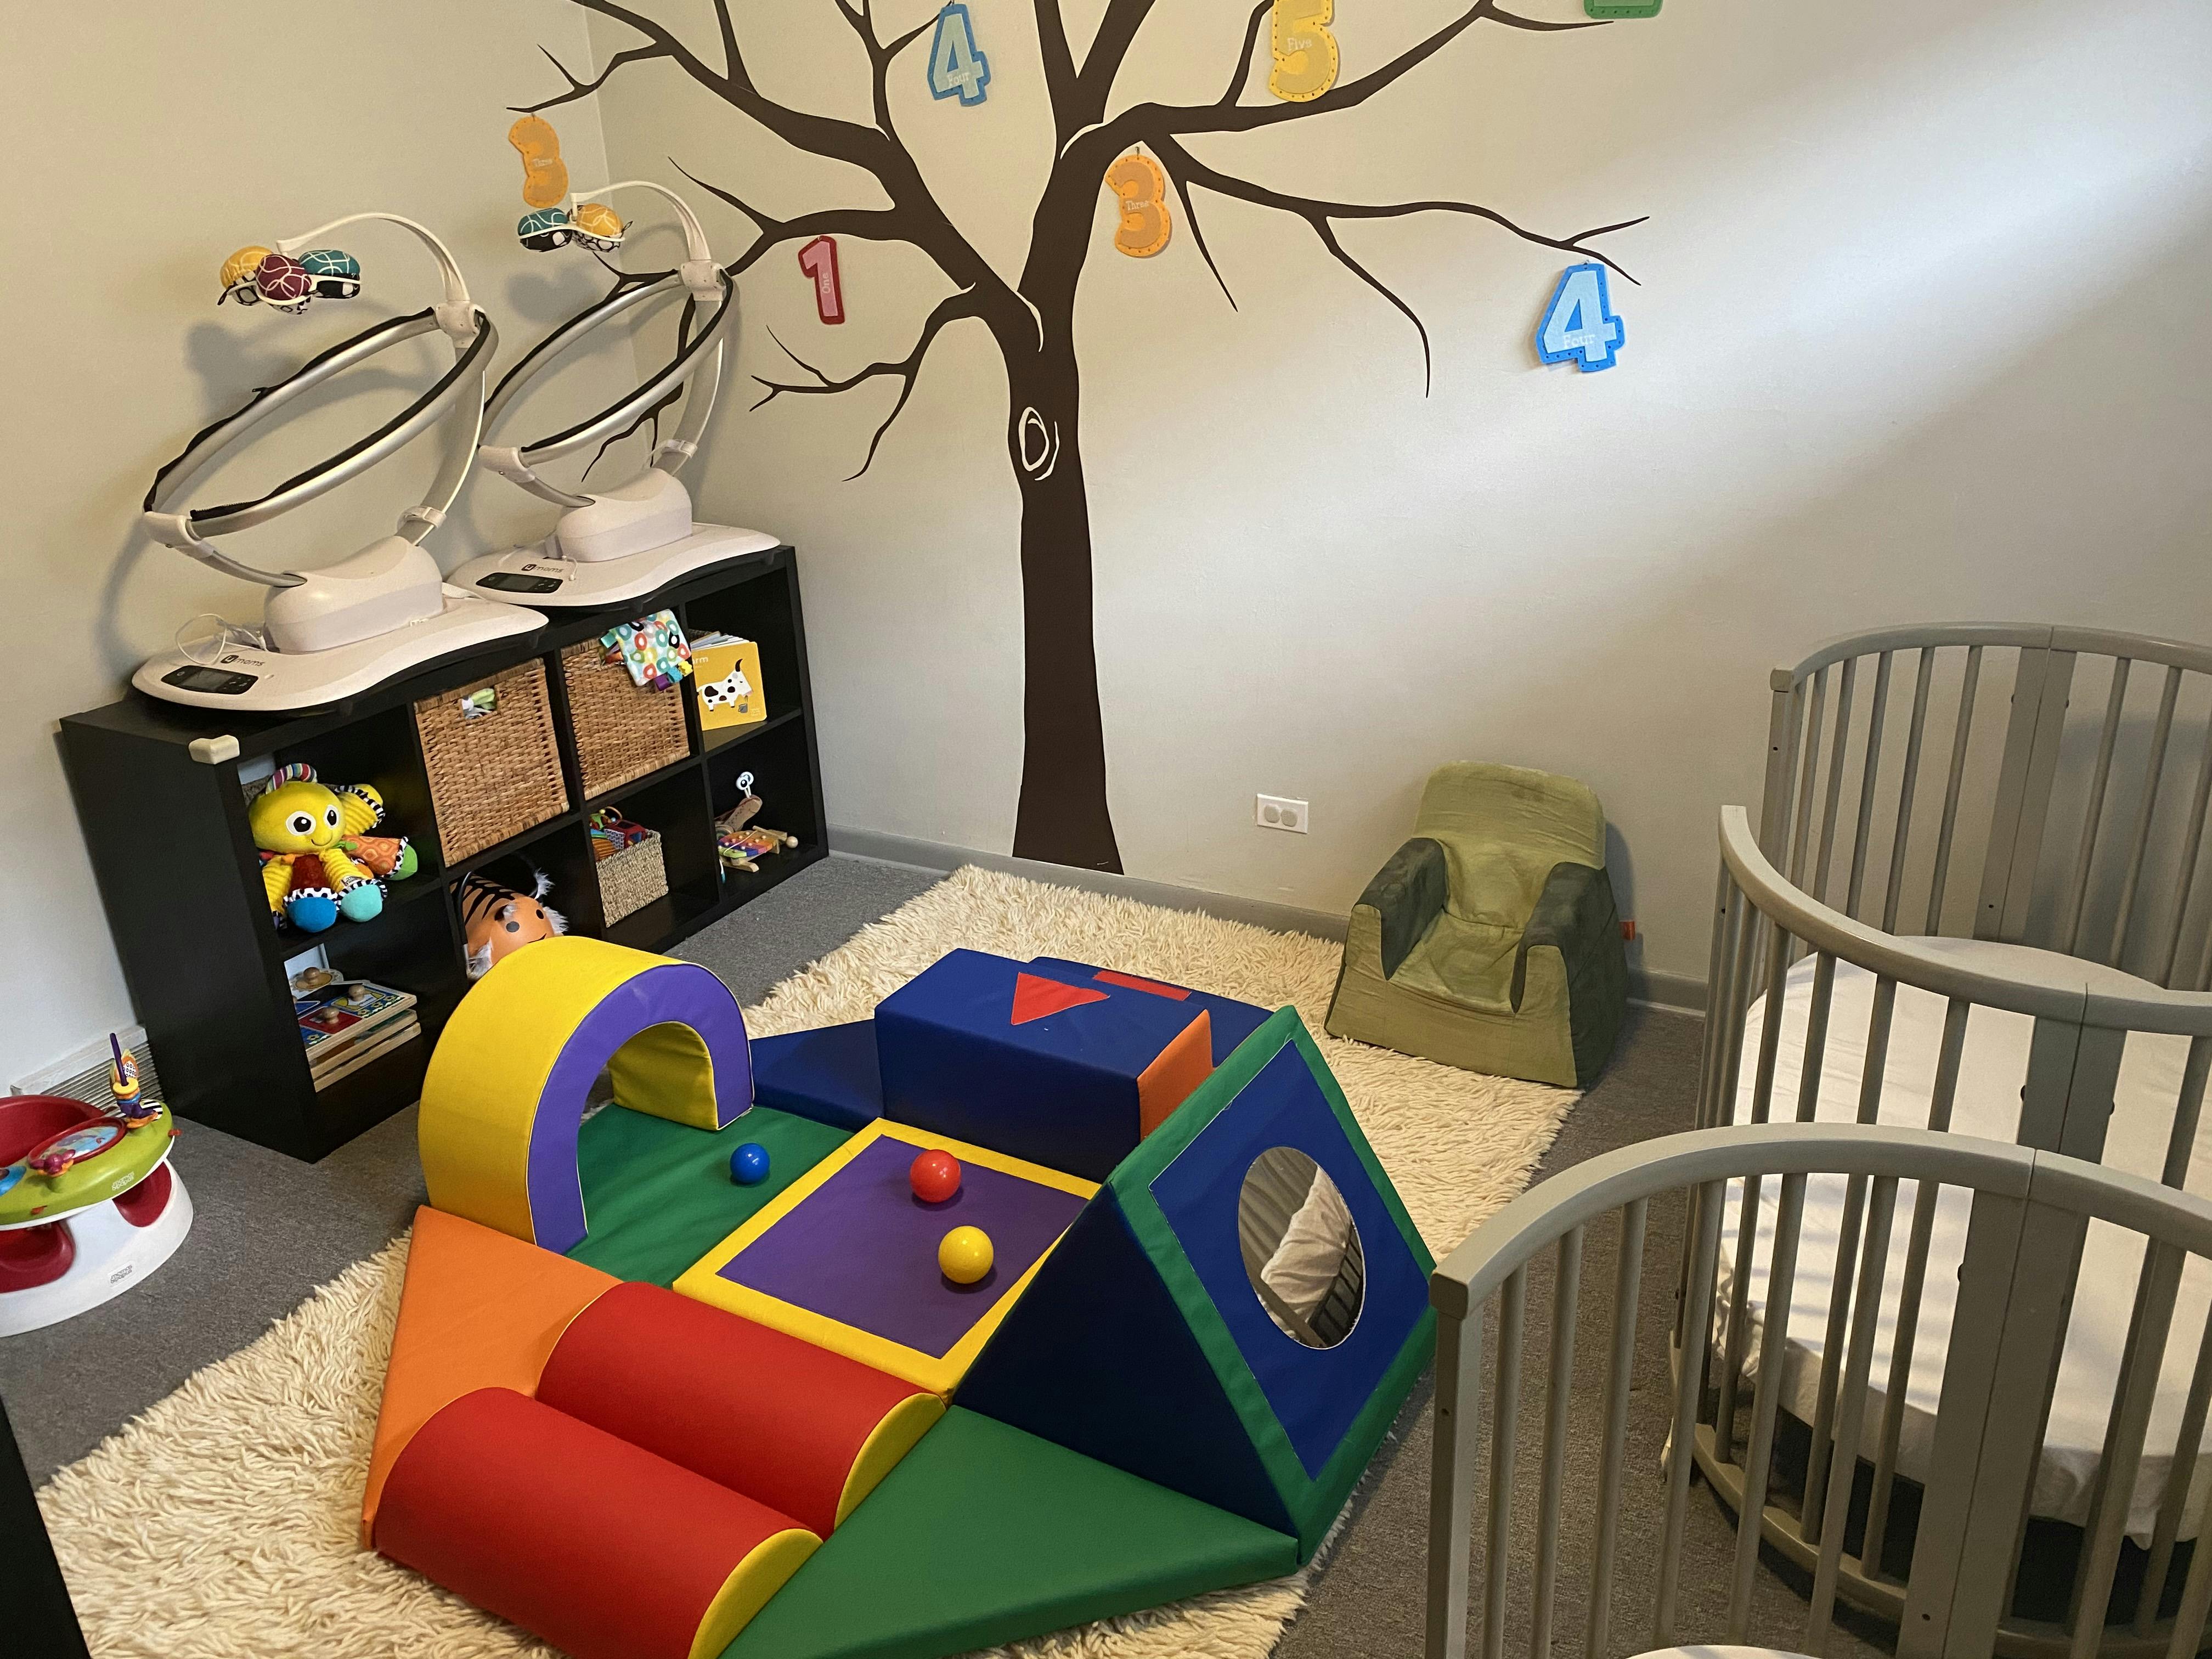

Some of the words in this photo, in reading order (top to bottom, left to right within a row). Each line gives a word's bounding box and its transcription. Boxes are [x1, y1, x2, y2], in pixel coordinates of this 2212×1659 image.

[932, 12, 985, 100] 4
[947, 72, 970, 88] Four
[1274, 0, 1332, 95] 5
[1287, 37, 1312, 50] Five
[514, 121, 565, 204] 3
[1109, 160, 1163, 250] 3
[802, 240, 839, 318] 1
[822, 272, 831, 294] One
[1542, 269, 1618, 363] 4
[1564, 334, 1595, 348] Four
